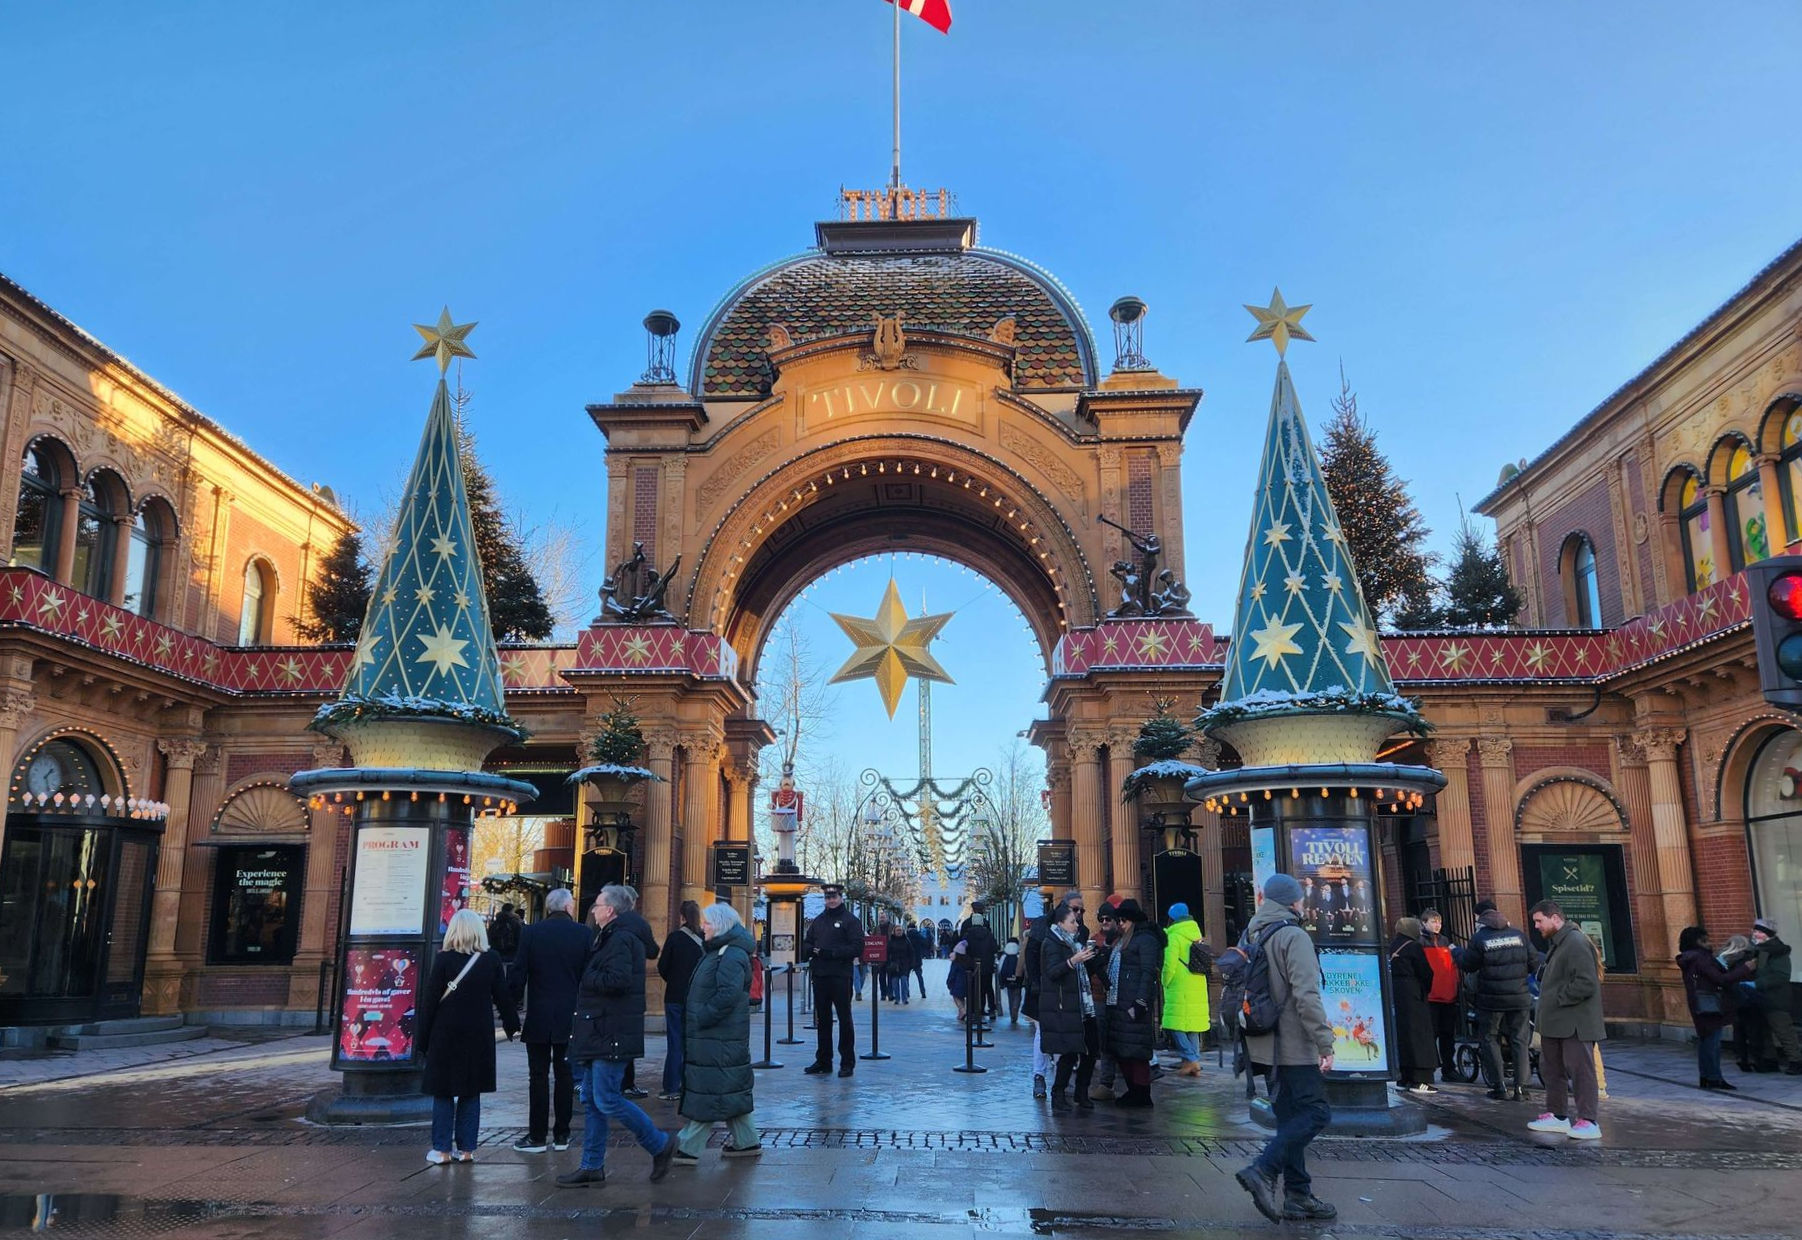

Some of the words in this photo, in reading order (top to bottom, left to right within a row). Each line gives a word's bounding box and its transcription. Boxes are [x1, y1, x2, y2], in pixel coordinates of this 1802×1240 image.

[844, 188, 946, 221] TIVOLI
[812, 381, 961, 418] TIVOLI
[362, 841, 419, 850] PROGRAM
[1305, 841, 1360, 854] TIVOLI
[1302, 853, 1364, 865] REVYEN
[236, 869, 287, 879] Experience
[238, 878, 254, 886] the
[255, 878, 283, 887] magic
[1552, 884, 1595, 893] Spisetid?
[1326, 972, 1359, 980] DYRENE
[1330, 986, 1360, 994] SKOVEN
